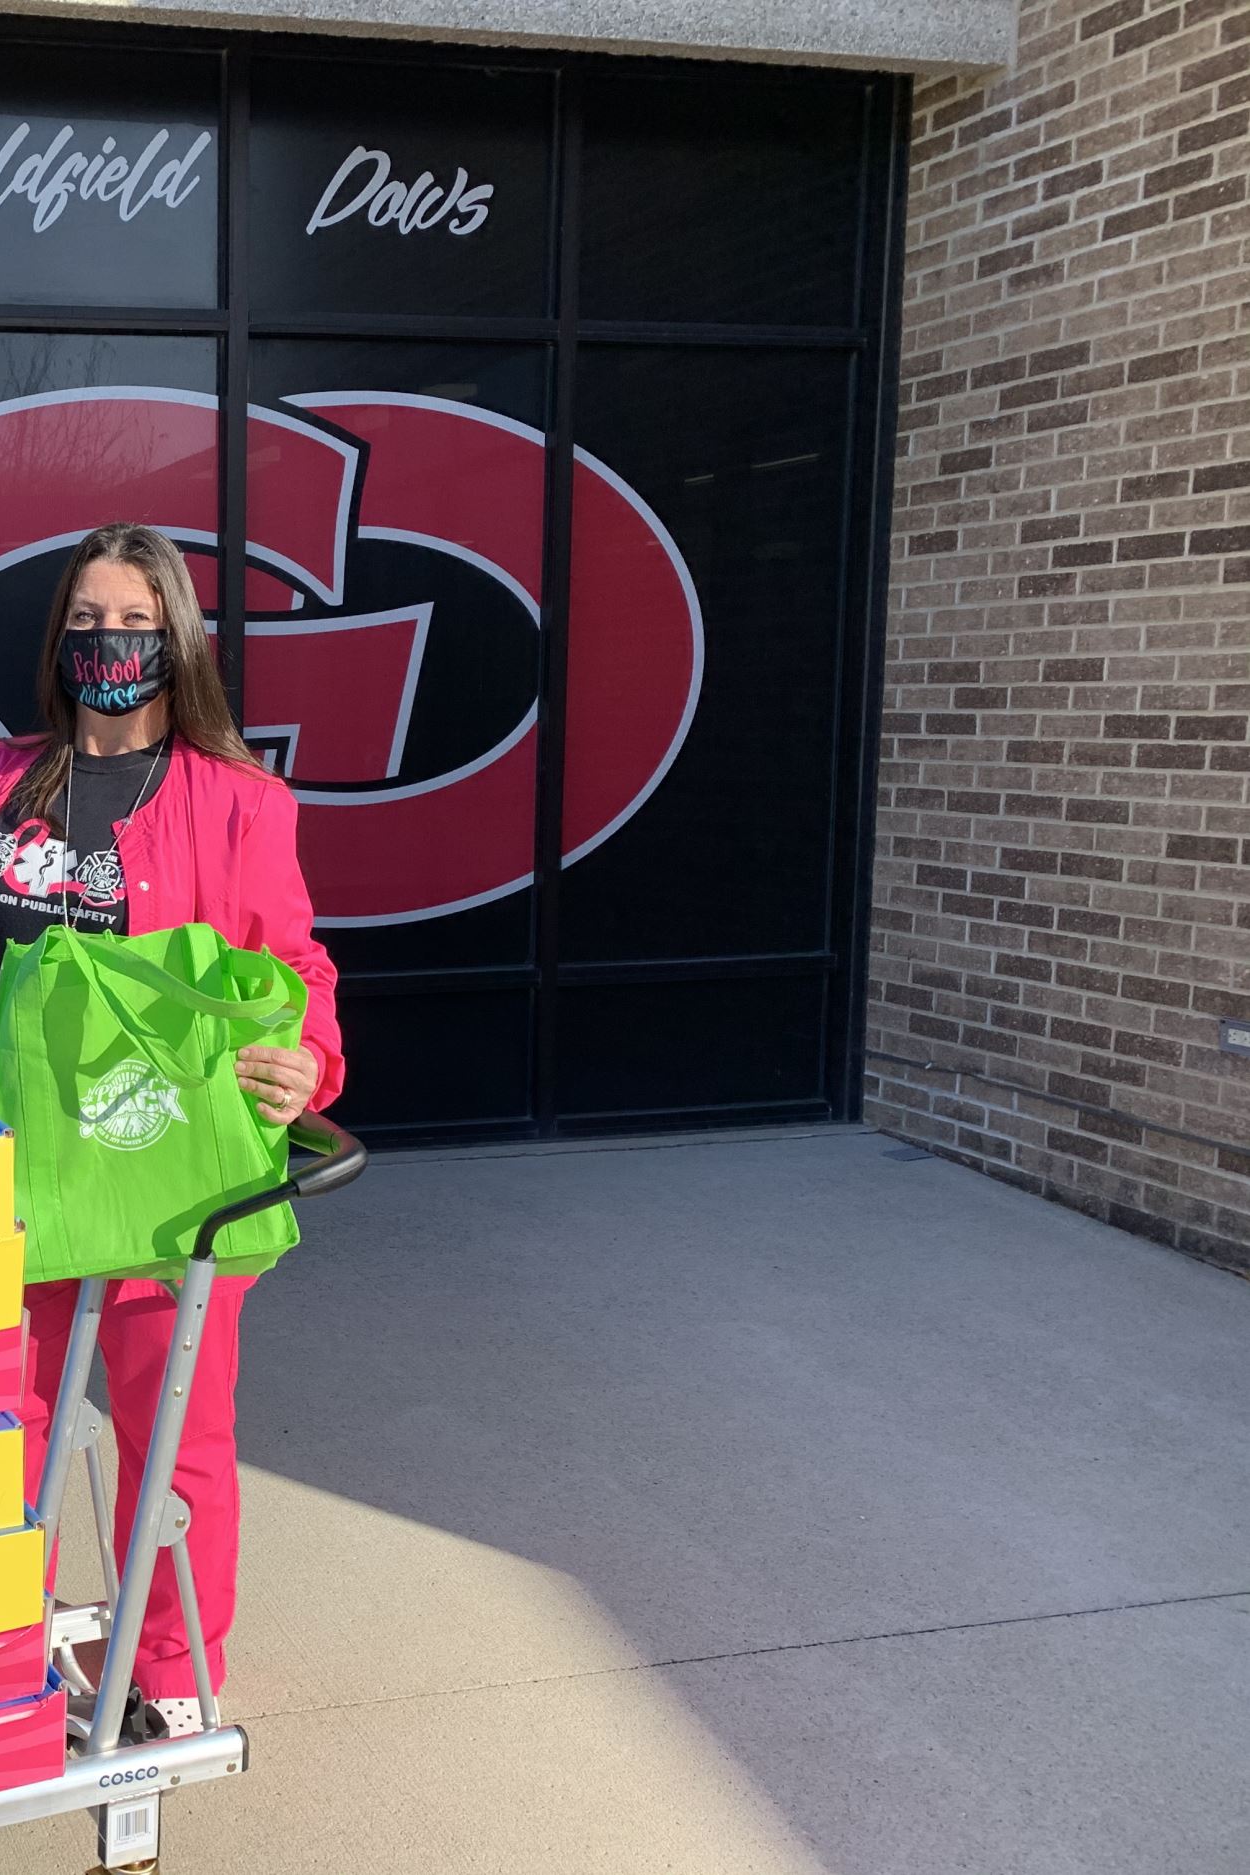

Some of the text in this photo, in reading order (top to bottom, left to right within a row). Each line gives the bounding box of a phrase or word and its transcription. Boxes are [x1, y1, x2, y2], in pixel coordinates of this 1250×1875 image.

[306, 146, 494, 236] Dows
[73, 648, 143, 683] School
[21, 898, 66, 916] PUBLIC
[70, 907, 117, 924] SAFETY
[99, 1765, 159, 1788] COSCO
